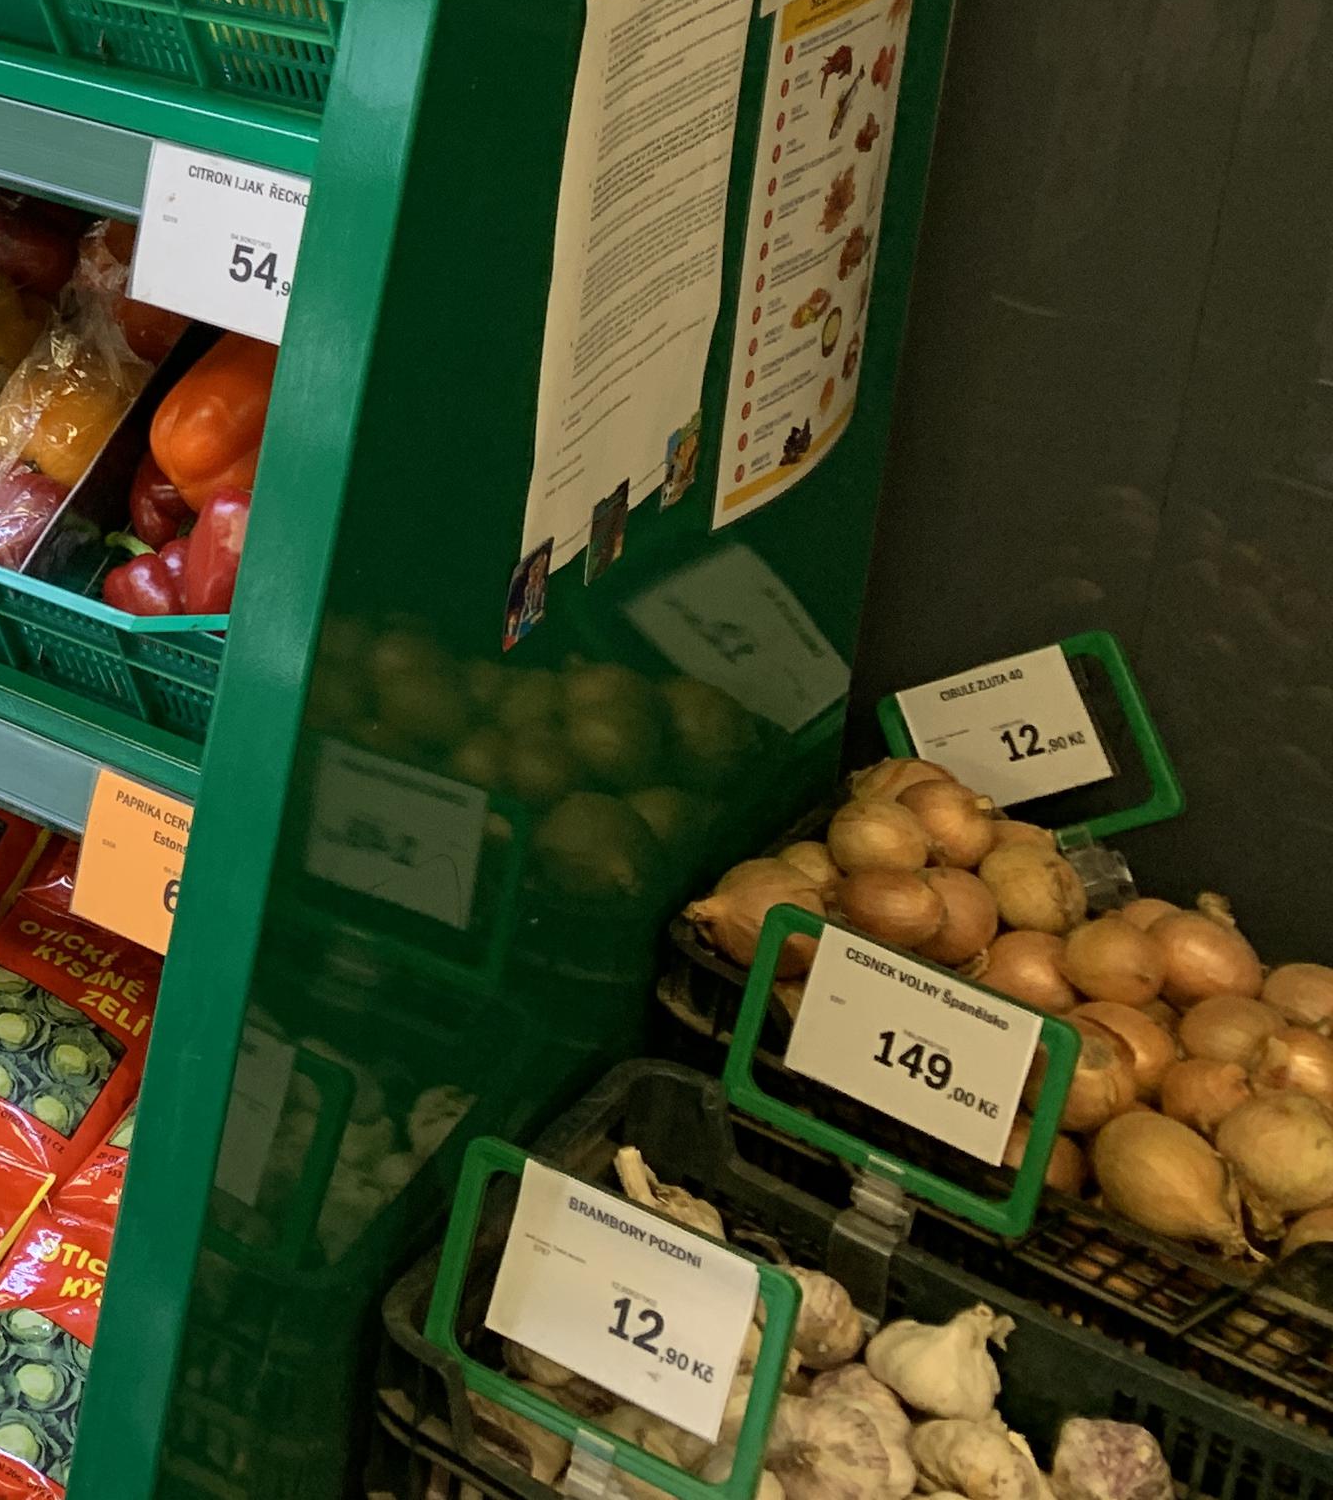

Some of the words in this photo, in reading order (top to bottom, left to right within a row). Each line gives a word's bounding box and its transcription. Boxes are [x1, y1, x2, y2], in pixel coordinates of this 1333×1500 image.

[188, 164, 232, 188] CITRON
[940, 680, 977, 702] CIBULE
[977, 674, 1009, 693] ZLUTA
[1009, 668, 1024, 681] 40
[1067, 730, 1086, 747] Kč
[116, 789, 162, 821] PAPRIKA
[18, 918, 122, 970] OTICKÉ
[33, 944, 150, 1005] KYSANÉ
[846, 947, 896, 981] CESNEK
[898, 971, 942, 999] VOLNY
[941, 989, 1010, 1032] Španělsko
[78, 989, 151, 1040] ZELÍ
[977, 1098, 999, 1120] Kč
[568, 1196, 648, 1244] BRAMBORY
[648, 1234, 702, 1269] POZDNI
[691, 1361, 715, 1385] Kč
